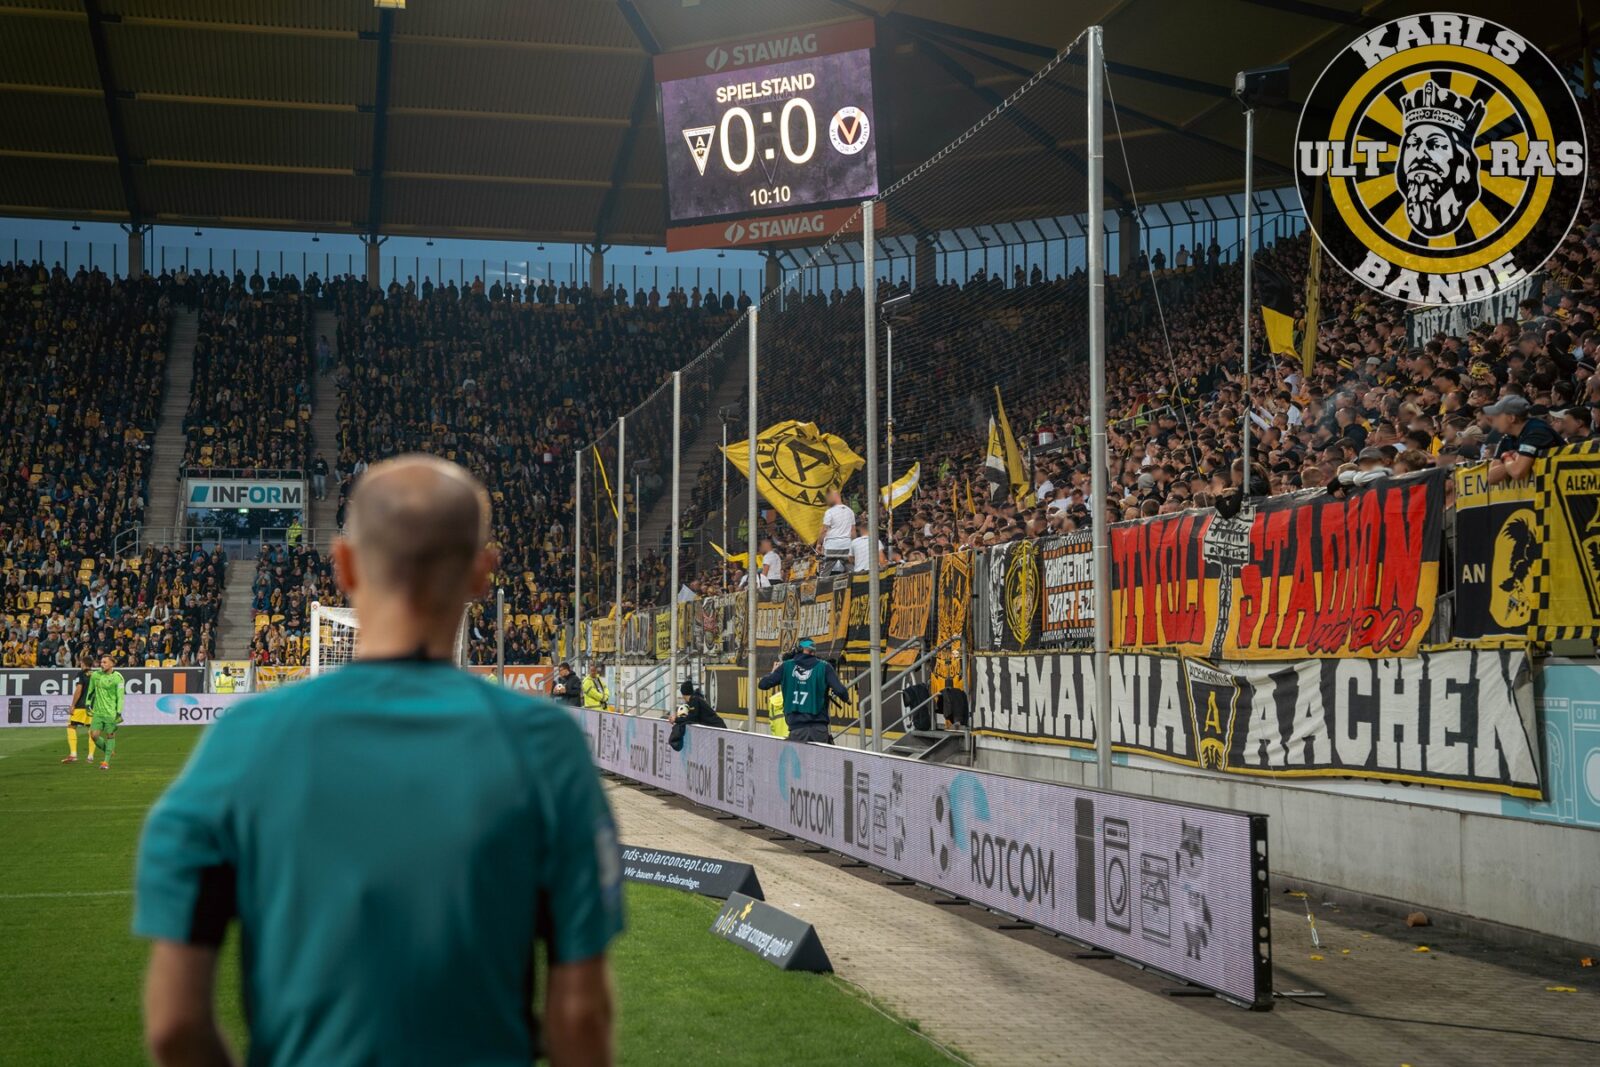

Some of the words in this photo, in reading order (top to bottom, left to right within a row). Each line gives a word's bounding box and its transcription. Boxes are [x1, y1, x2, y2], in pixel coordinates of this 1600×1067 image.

[733, 33, 818, 66] STAWAG
[716, 72, 816, 103] SPIELSTAND
[720, 97, 817, 173] 0:0
[750, 185, 791, 206] 10:10
[749, 214, 825, 240] STAWAG
[212, 485, 300, 504] INFORM
[1462, 563, 1486, 584] AN
[792, 690, 809, 705] 17
[973, 655, 1187, 755] ALEMANNIA
[1242, 649, 1539, 785] AACHEN
[790, 786, 834, 838] ROTCOM
[622, 848, 723, 875] nds-solarconcept.com
[970, 829, 1055, 910] ROTCOM
